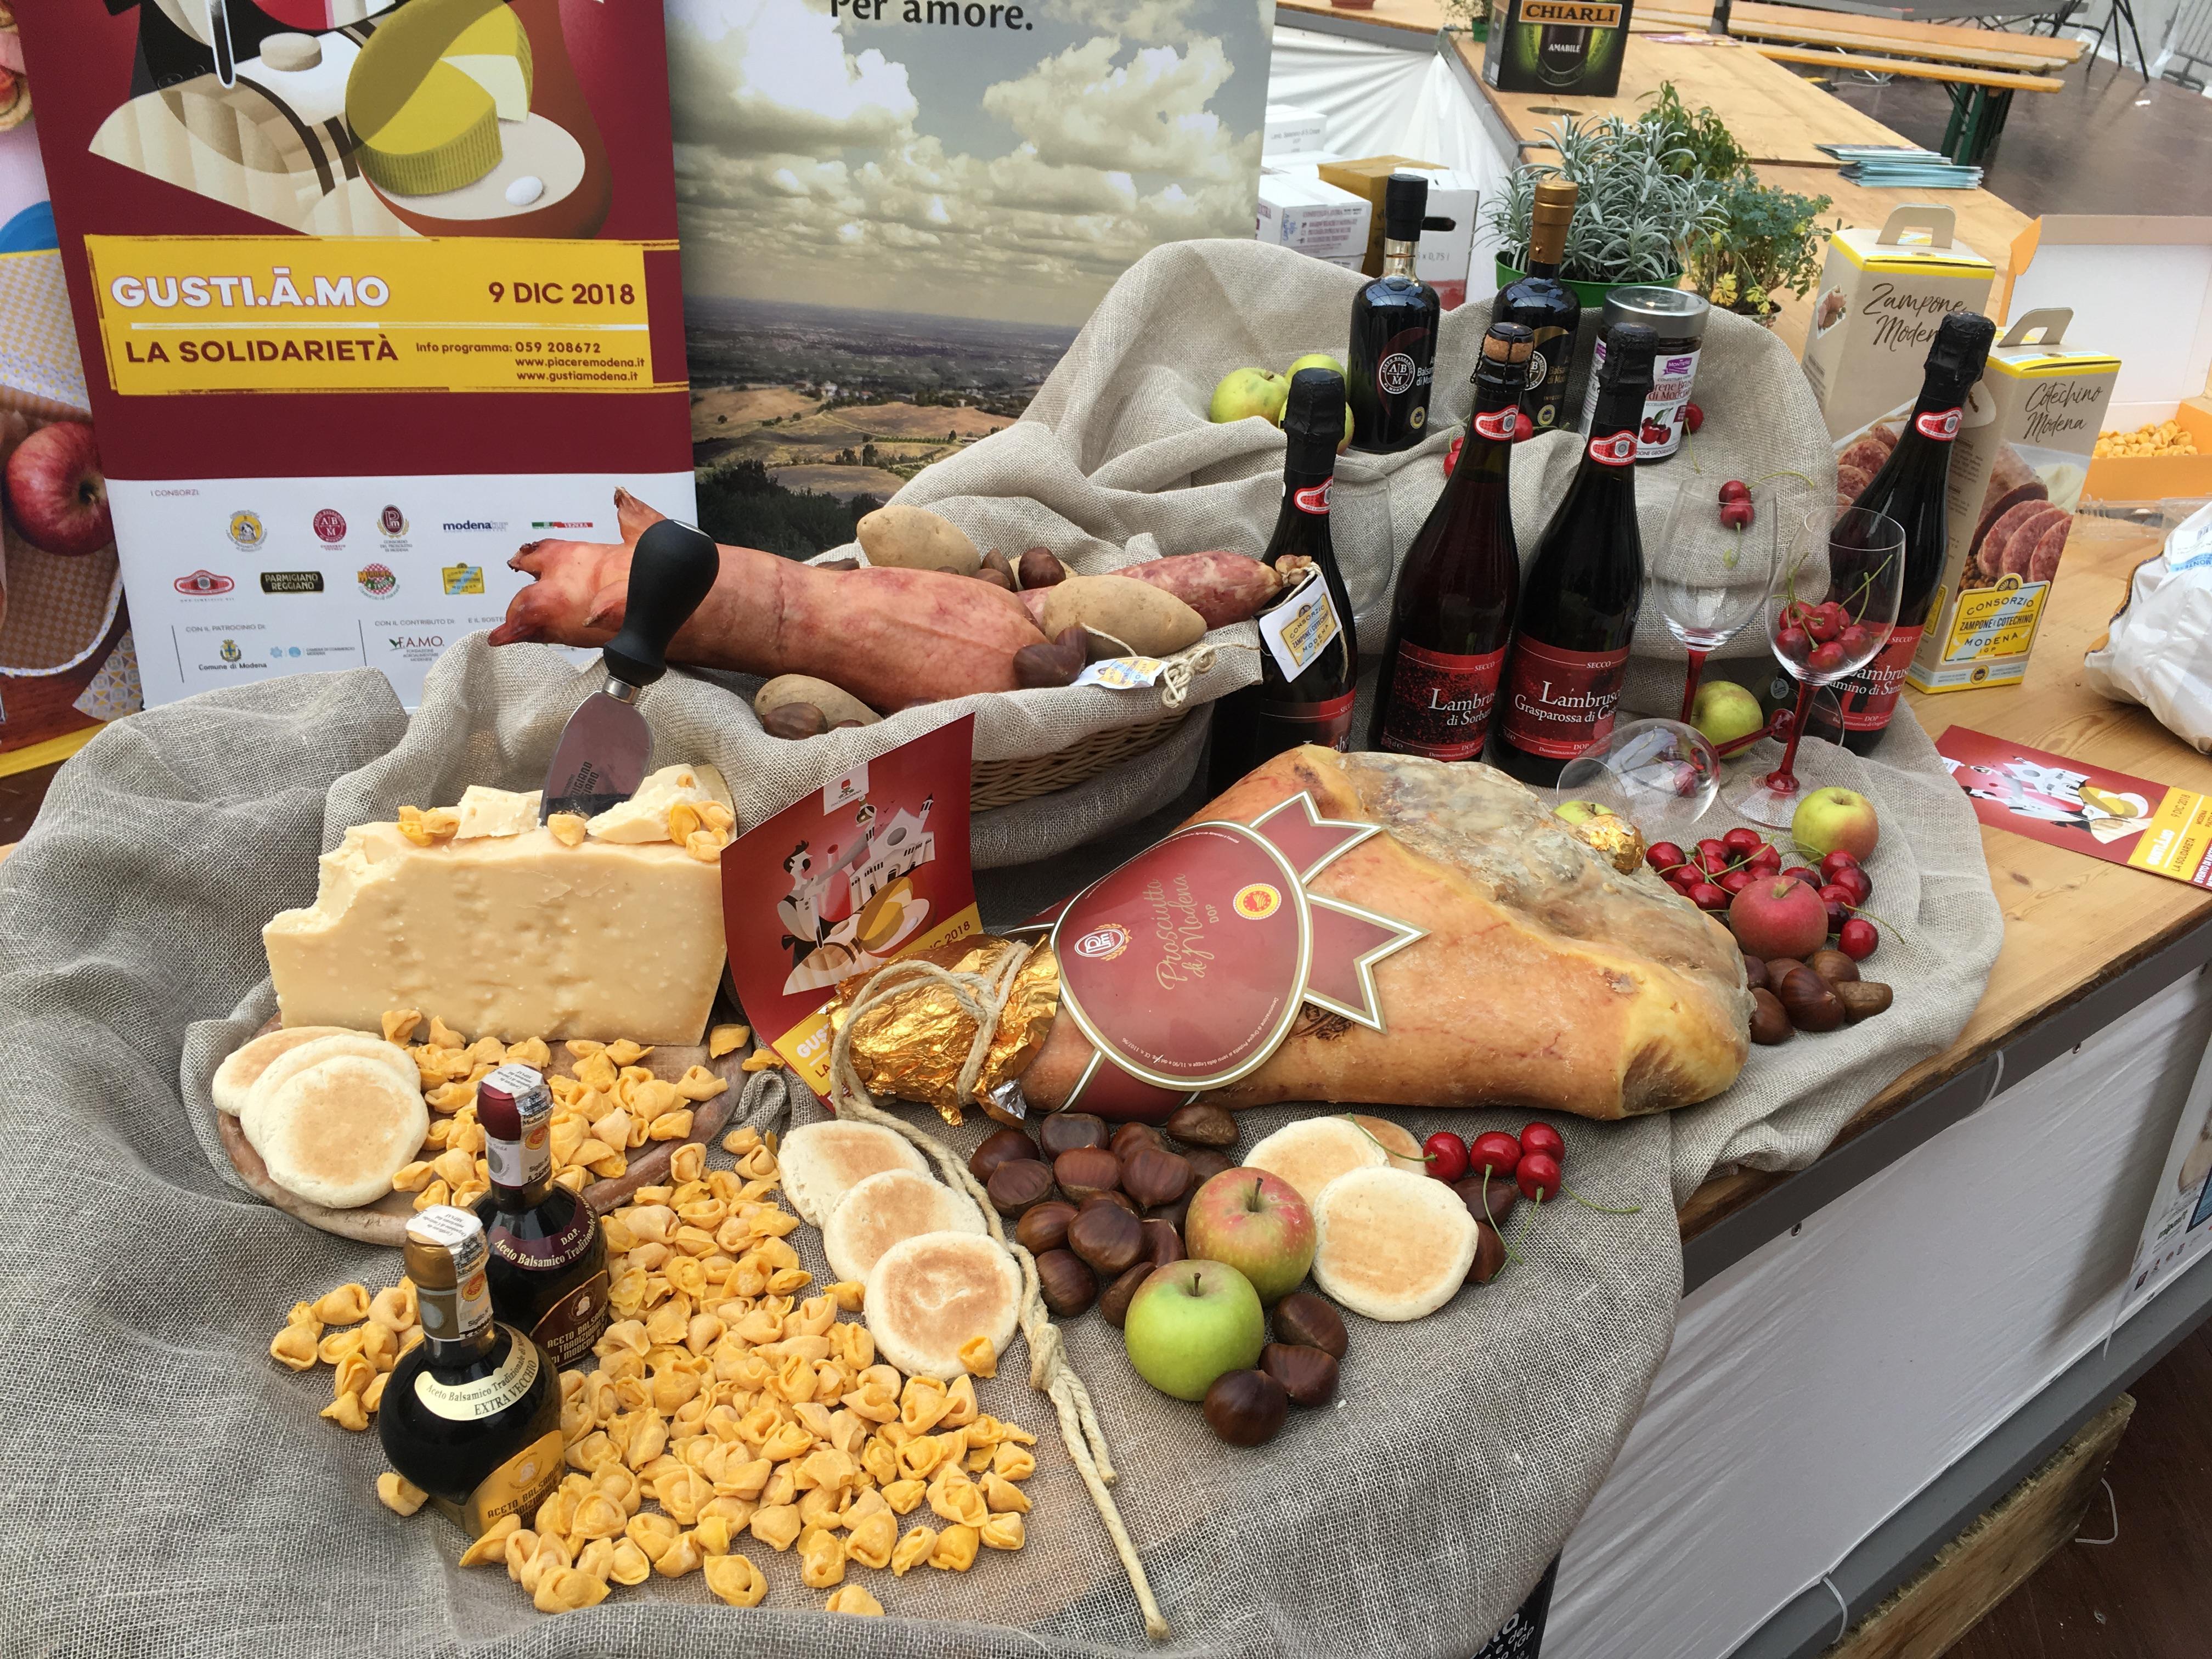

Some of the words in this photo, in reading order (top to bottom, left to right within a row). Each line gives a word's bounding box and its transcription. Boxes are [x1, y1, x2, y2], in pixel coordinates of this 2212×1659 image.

[902, 0, 1033, 31] amore.
[1526, 4, 1616, 22] CHIARLI
[1548, 43, 1581, 53] AMABILE
[488, 281, 505, 303] 9
[514, 282, 563, 304] DIC
[572, 283, 635, 304] 2018
[1863, 283, 1967, 318] Zampone
[125, 341, 170, 363] LA
[179, 334, 399, 363] SOLIDARIETÀ
[416, 342, 439, 353] Info
[442, 343, 512, 354] programma:
[515, 341, 542, 353] 059
[548, 342, 601, 353] 208672
[515, 357, 645, 369] www.piaceremodena.it
[516, 371, 638, 382] www.gustiamodena.it
[1654, 383, 1677, 392] rene
[2025, 381, 2104, 413] Cotechino
[2023, 410, 2087, 443] Modena
[265, 573, 318, 583] PARMIGIANO
[271, 582, 314, 590] REGGIANO
[1966, 597, 2034, 616] CONSORZIO
[1290, 605, 1325, 639] CONSORZIO
[1959, 618, 1994, 631] ZAMPONE
[1996, 613, 2034, 628] COTECHINO
[1964, 631, 2018, 646] MODENA
[1474, 661, 1495, 672] SECCO
[1586, 661, 1611, 669] SECCO
[1828, 680, 1867, 694] amino
[1869, 686, 1879, 696] di
[1514, 693, 1582, 723] Grasparossa
[1584, 711, 1595, 723] di
[1447, 715, 1458, 726] di
[2171, 864, 2182, 872] LA
[1167, 873, 1215, 960] Modena
[1205, 904, 1220, 924] DOP
[944, 921, 970, 944] 2018
[1143, 878, 1188, 990] Prosciutto
[1181, 959, 1207, 978] di
[1260, 997, 1279, 1026] Denominazione
[797, 1023, 830, 1058] GUS
[815, 1064, 831, 1079] LA
[494, 1238, 517, 1261] Aceto
[517, 1252, 565, 1267] Balsamico
[565, 1220, 596, 1260] Tradizionale
[560, 1228, 581, 1246] D.O.P.
[547, 1331, 574, 1348] ACETO
[426, 1384, 447, 1400] Aceto
[449, 1387, 492, 1402] Balsamico
[491, 1355, 526, 1392] Tradizionale
[518, 1347, 527, 1356] di
[473, 1393, 512, 1416] EXTRA
[508, 1359, 537, 1398] VECCHIO
[500, 1475, 558, 1517] DIZIONALE
[487, 1499, 518, 1519] ACETO
